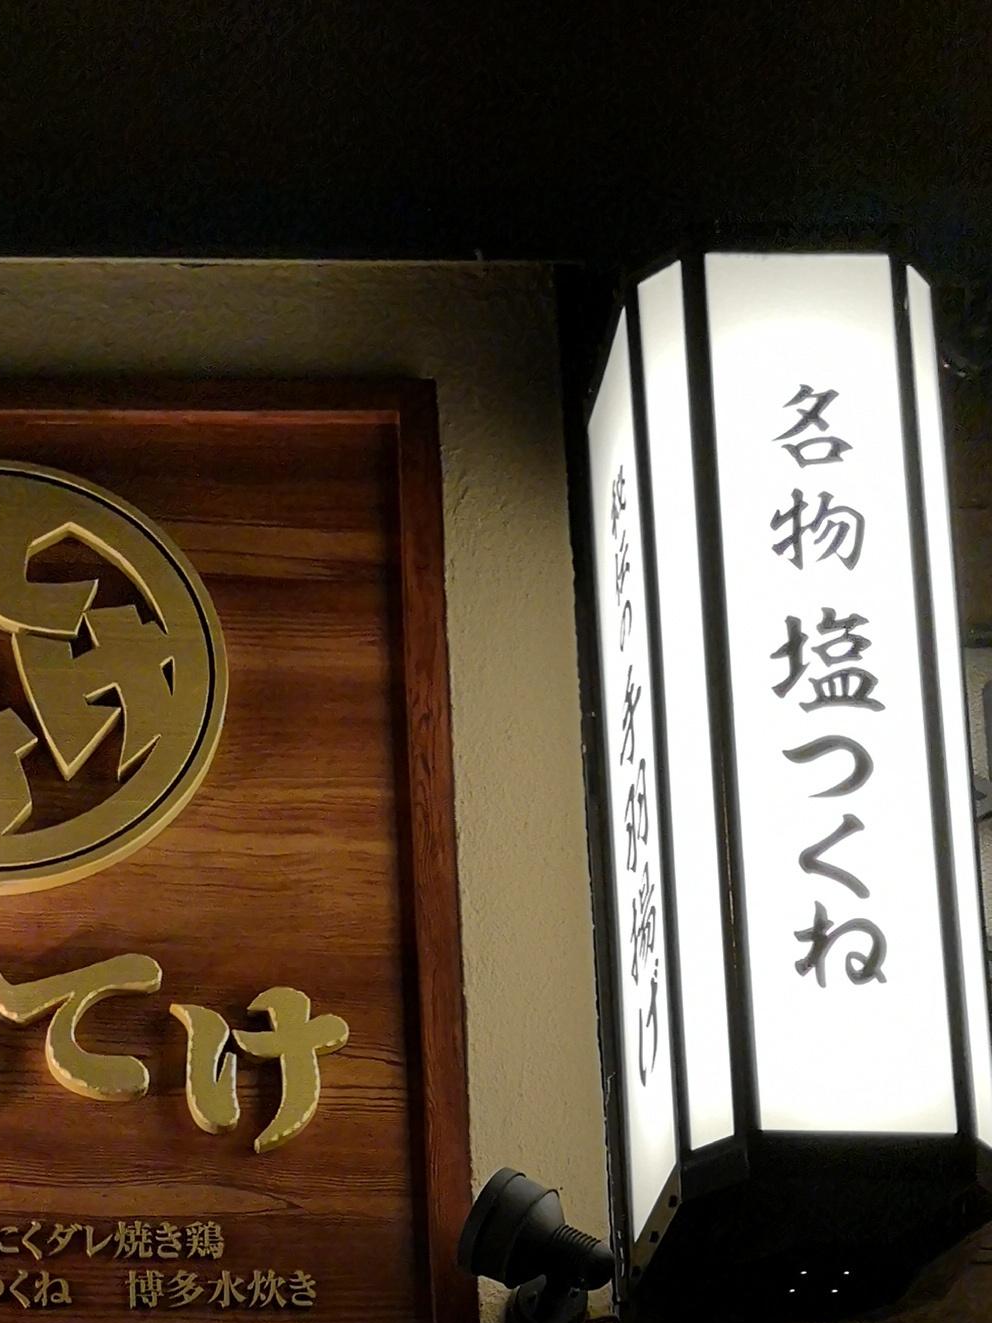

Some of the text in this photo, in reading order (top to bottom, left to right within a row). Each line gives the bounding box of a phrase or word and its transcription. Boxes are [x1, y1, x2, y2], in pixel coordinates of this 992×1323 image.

[125, 1268, 320, 1310] 博多水炊き
